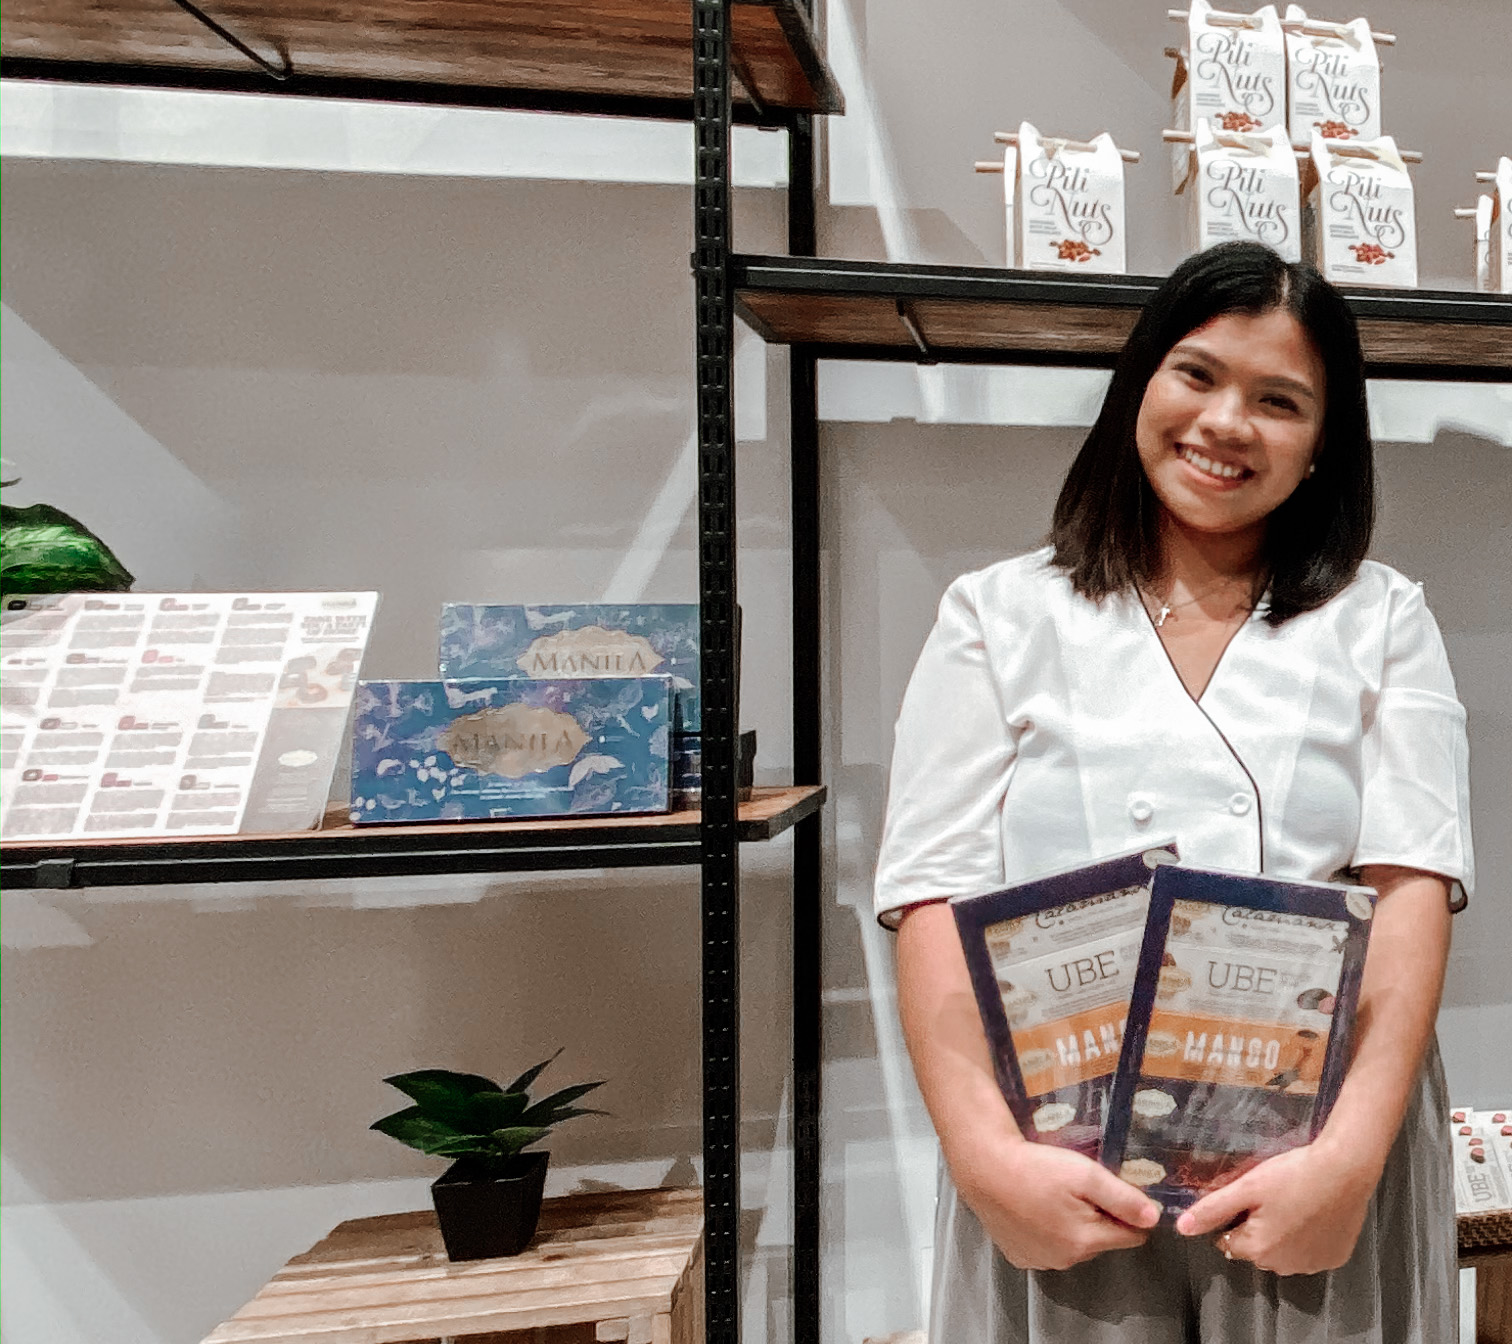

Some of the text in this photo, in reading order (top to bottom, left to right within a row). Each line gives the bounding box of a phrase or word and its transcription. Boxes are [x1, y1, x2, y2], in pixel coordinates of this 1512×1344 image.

[1196, 32, 1254, 67] Pili
[1295, 48, 1350, 78] Pili
[1197, 59, 1275, 117] Nuts
[1296, 69, 1370, 126] Nuts
[1028, 157, 1090, 193] Pili
[1206, 159, 1266, 194] Pili
[1327, 170, 1382, 200] Pili
[1030, 184, 1114, 246] Nuts
[1207, 186, 1289, 246] Nuts
[1329, 190, 1405, 249] Nuts
[532, 650, 647, 673] MANILA
[1045, 950, 1120, 992] UBE
[1207, 960, 1278, 995] UBE
[1056, 1018, 1127, 1067] MAN
[1183, 1030, 1281, 1071] MANGO
[1467, 1172, 1493, 1203] UBE
